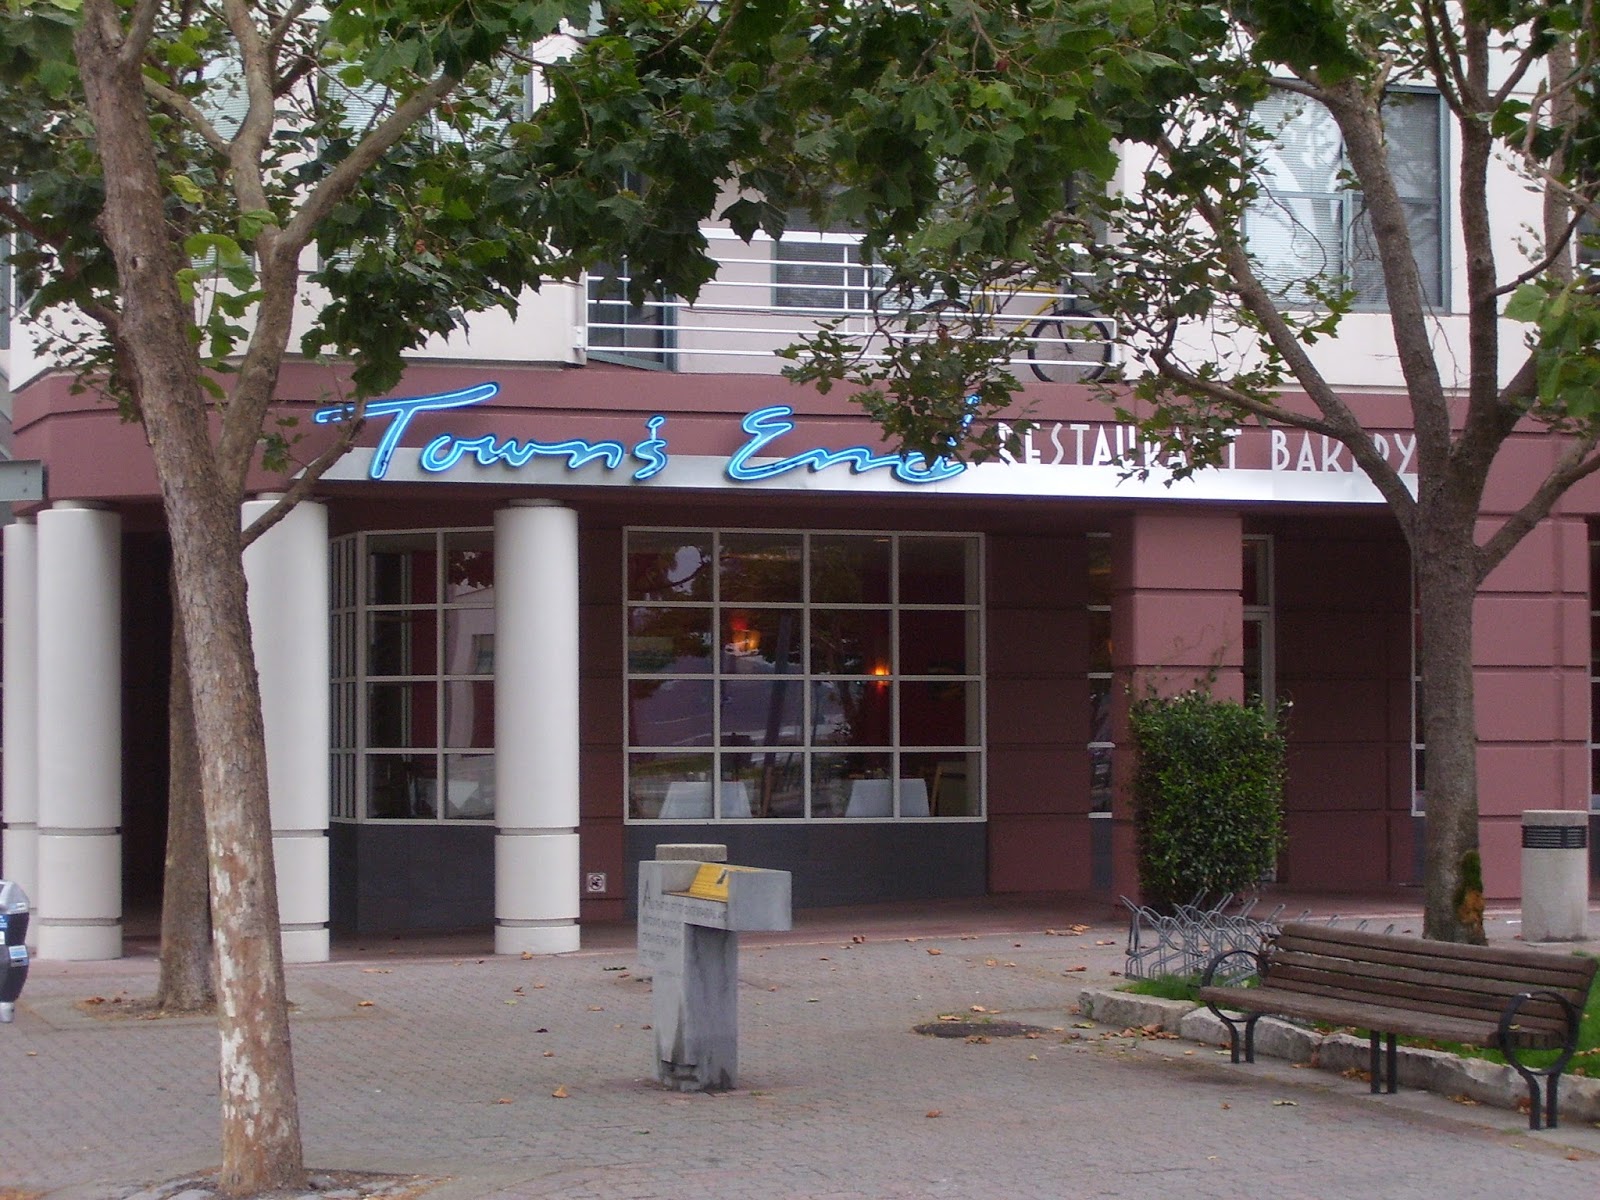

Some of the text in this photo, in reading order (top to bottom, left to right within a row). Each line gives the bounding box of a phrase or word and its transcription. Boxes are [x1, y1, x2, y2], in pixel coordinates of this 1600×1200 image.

[313, 381, 668, 481] Town's
[997, 422, 1417, 476] RESTAURAT BAKY
